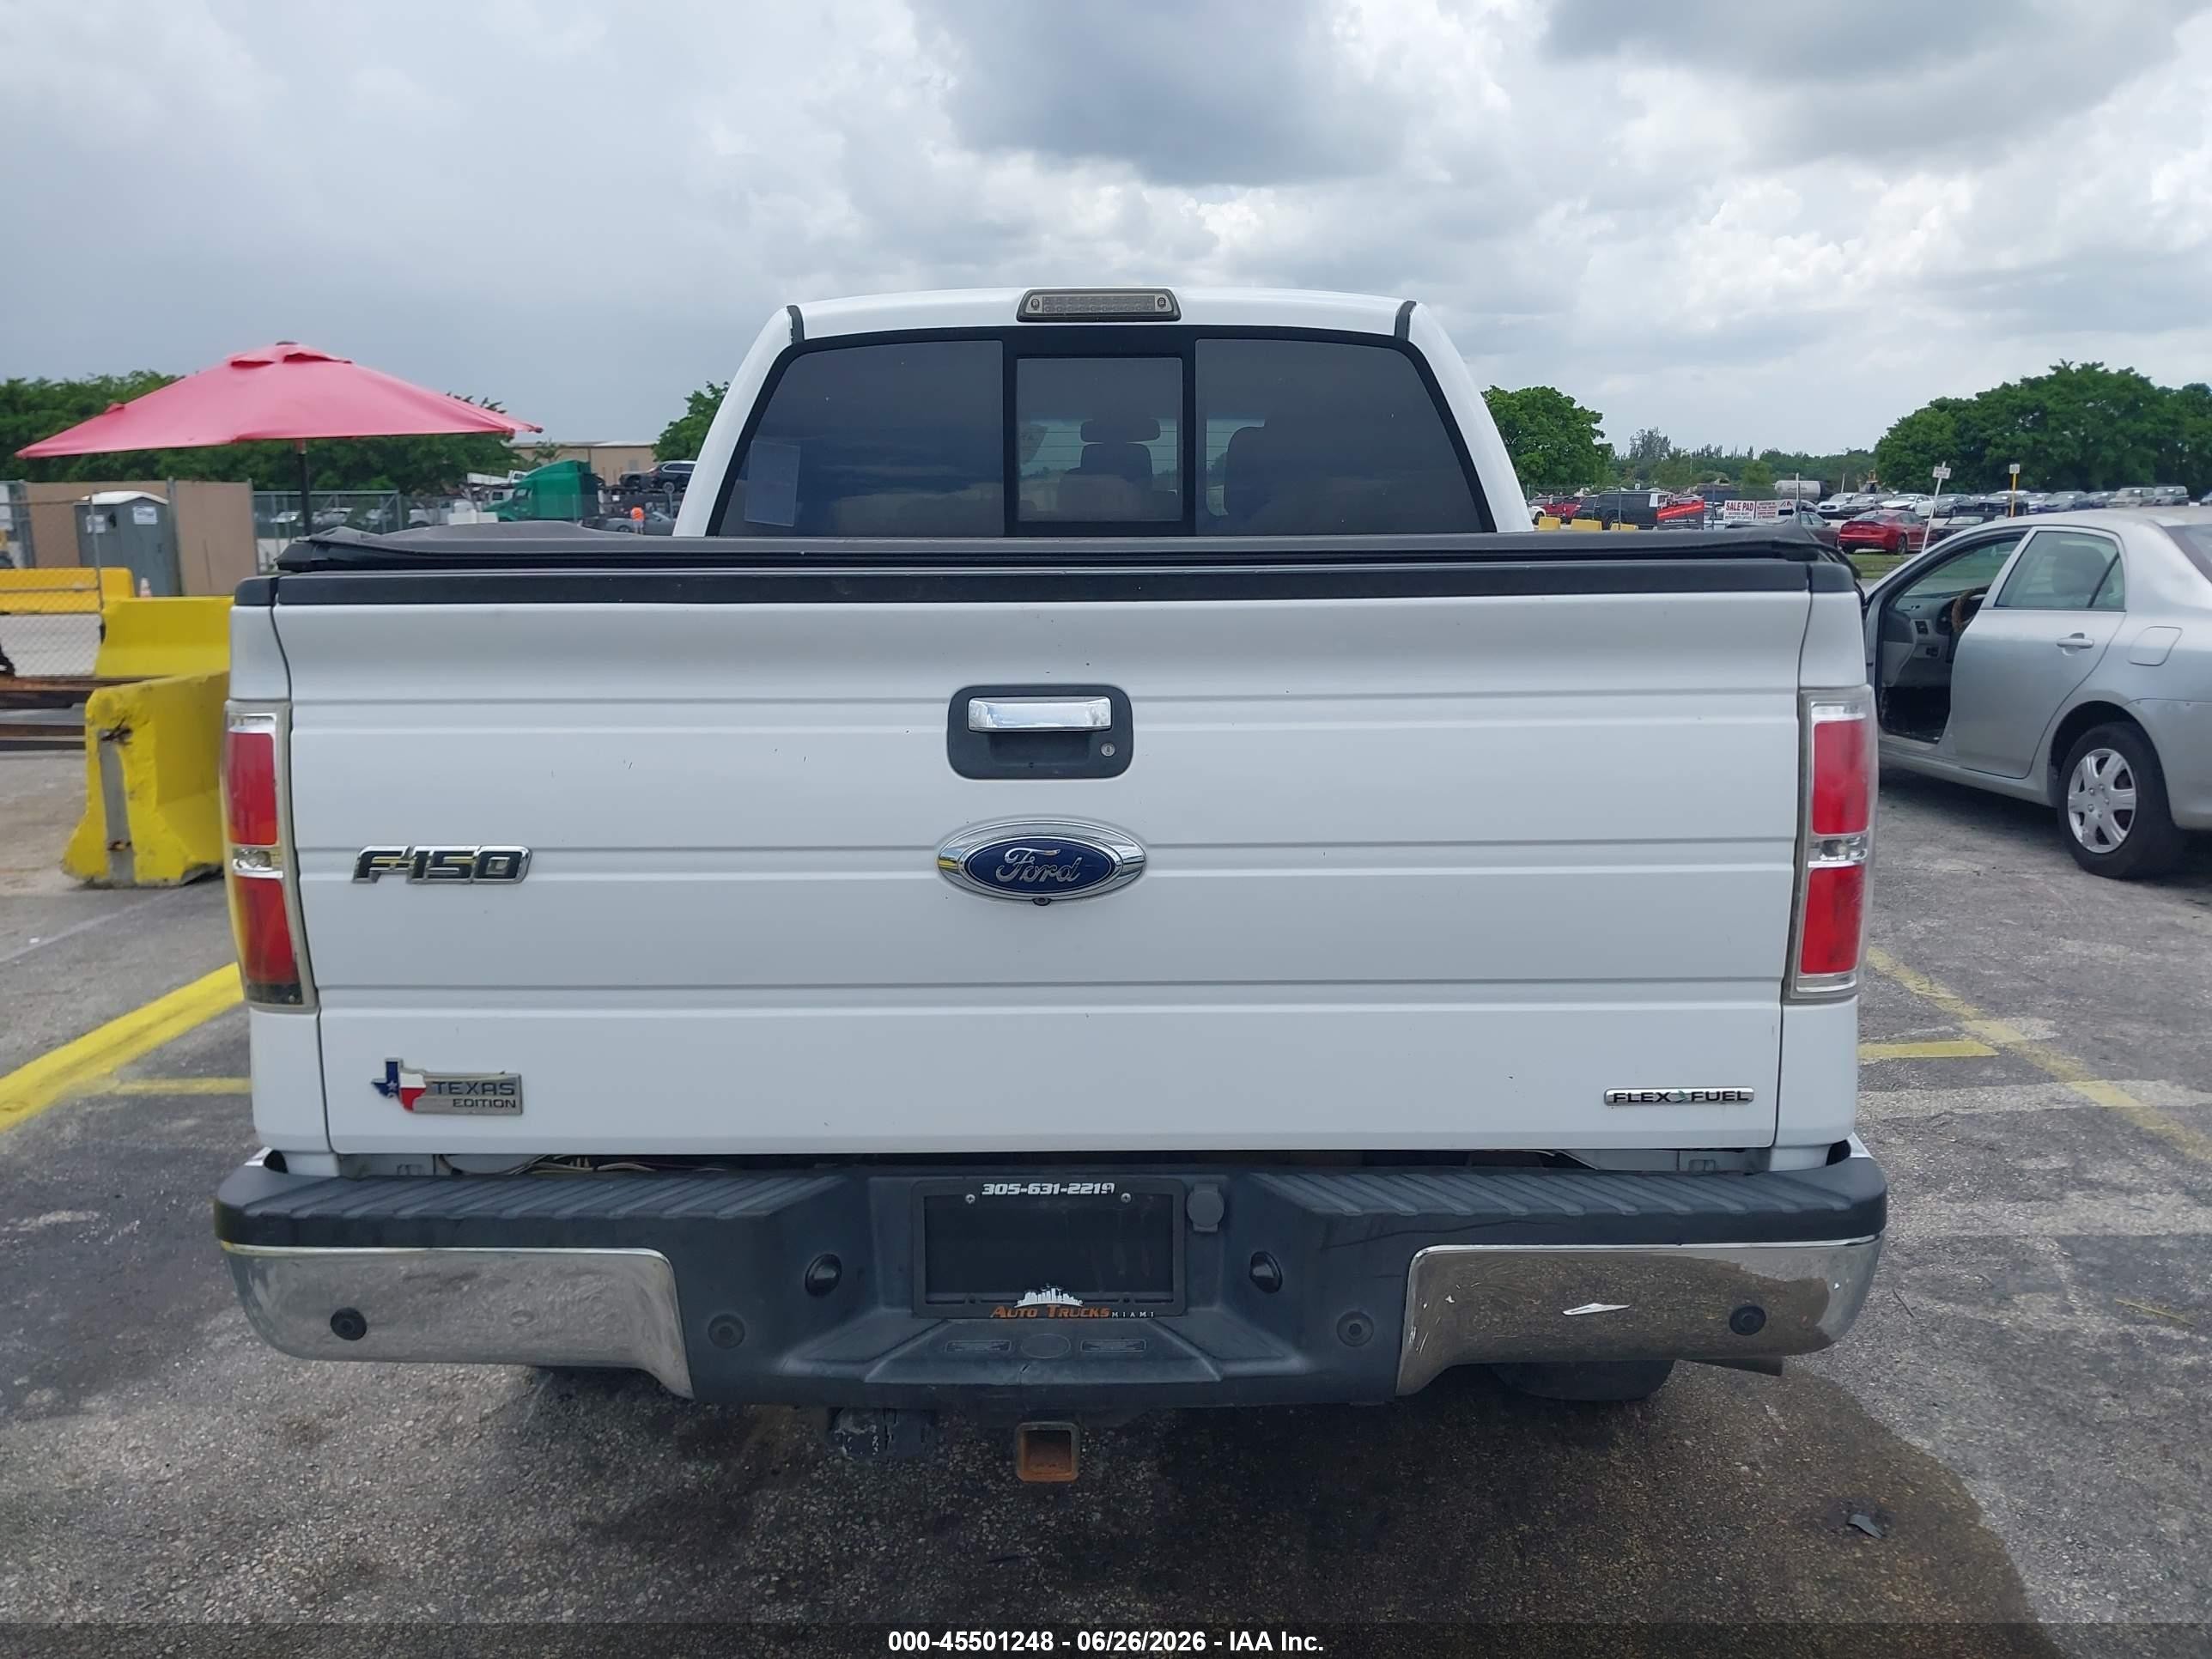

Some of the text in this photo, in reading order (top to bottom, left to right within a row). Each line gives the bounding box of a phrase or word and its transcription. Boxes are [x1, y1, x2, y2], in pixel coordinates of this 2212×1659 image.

[1726, 501, 1753, 511] SALE PAD
[351, 845, 532, 884] F-150
[995, 847, 1082, 882] Ford
[431, 1080, 515, 1097] TEXAS
[453, 1098, 516, 1108] EDITION
[1613, 1091, 1749, 1103] FLEX FUEL
